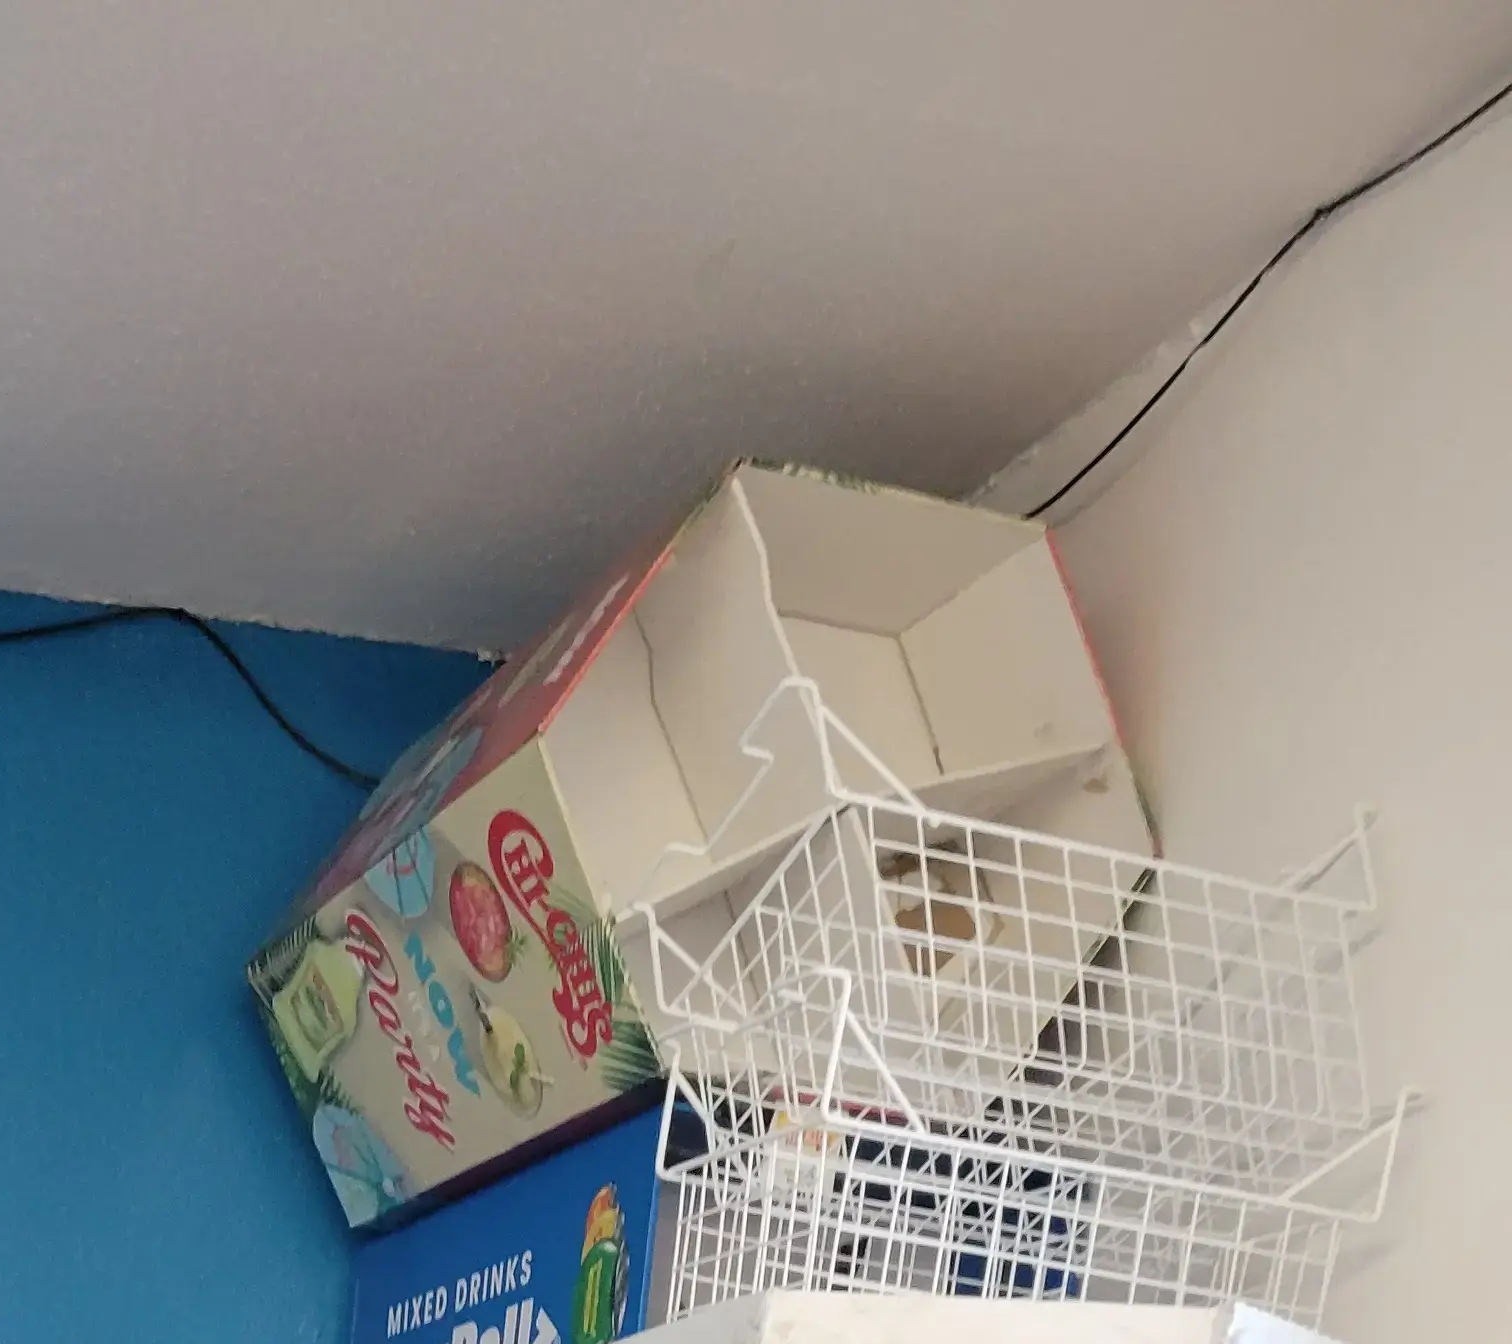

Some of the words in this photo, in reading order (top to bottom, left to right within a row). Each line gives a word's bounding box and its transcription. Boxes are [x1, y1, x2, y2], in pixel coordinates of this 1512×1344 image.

[345, 911, 457, 1153] Party
[403, 929, 481, 1097] NOW
[387, 1285, 448, 1340] MIXED
[454, 1249, 533, 1313] DRINKS
